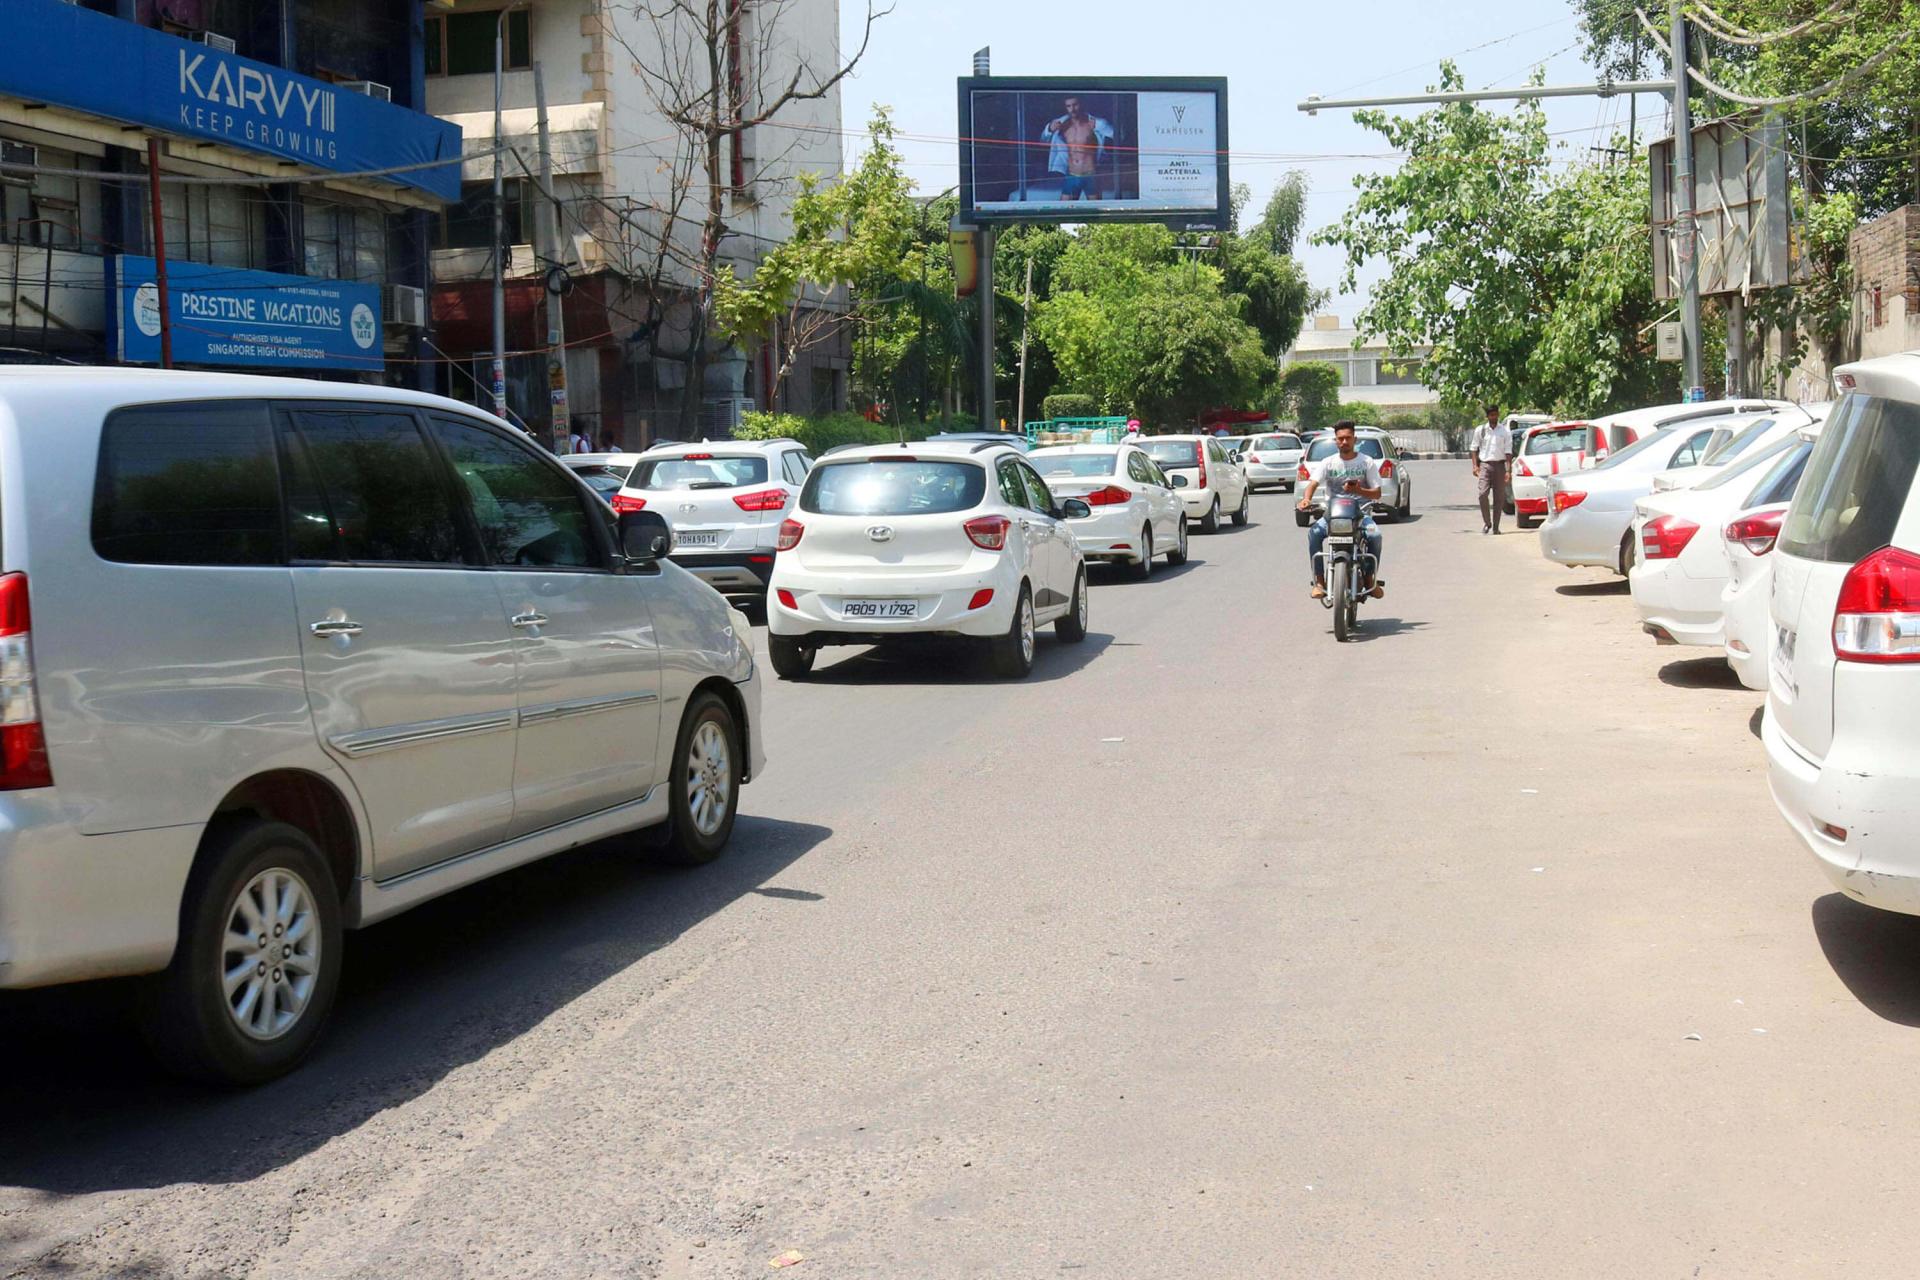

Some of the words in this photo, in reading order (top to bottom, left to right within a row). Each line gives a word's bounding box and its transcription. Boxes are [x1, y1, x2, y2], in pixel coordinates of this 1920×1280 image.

[181, 104, 233, 135] KEEP
[246, 121, 337, 159] GROWING
[182, 293, 256, 320] PRISTINE
[263, 301, 341, 326] VACATIONS
[284, 336, 302, 345] AGENT
[208, 344, 255, 356] SINGAPORE
[257, 346, 276, 357] HIGH
[278, 347, 325, 359] COMMISSION
[845, 604, 876, 615] PB09
[880, 604, 887, 615] Y
[889, 604, 916, 615] 1792
